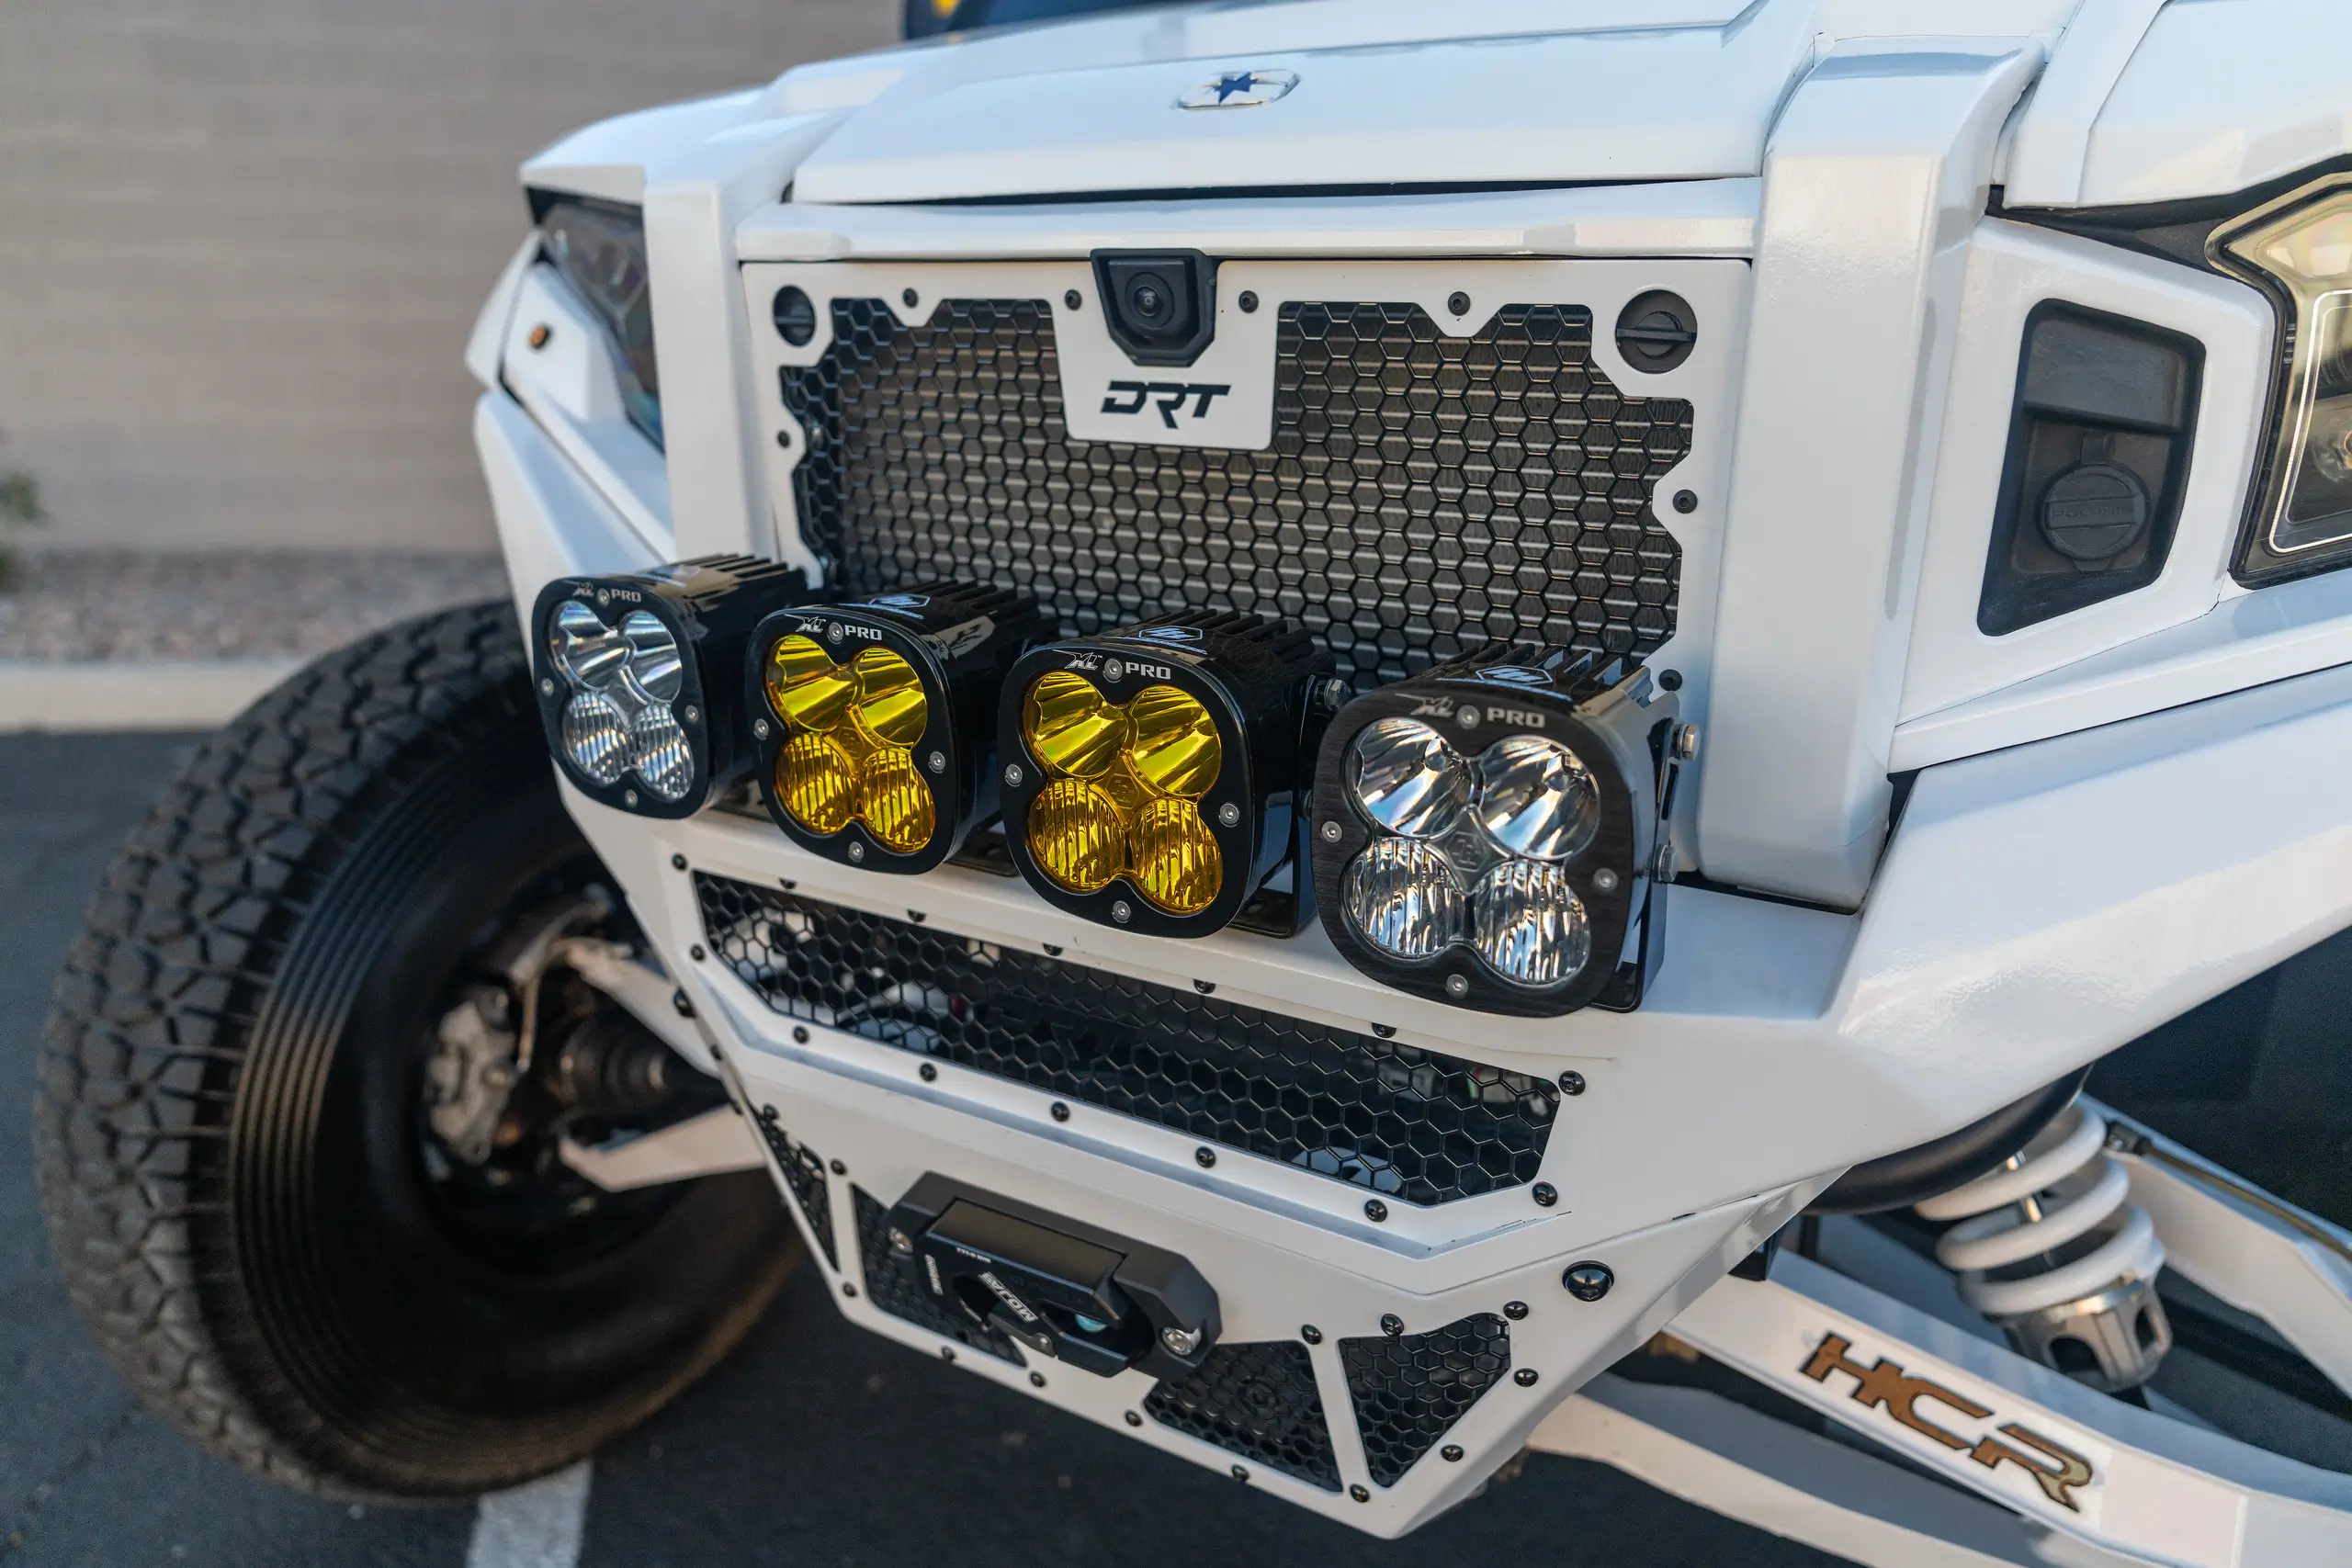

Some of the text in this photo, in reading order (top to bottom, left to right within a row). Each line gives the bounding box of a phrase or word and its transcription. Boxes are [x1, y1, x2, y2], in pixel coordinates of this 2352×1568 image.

[1100, 380, 1232, 429] DRT
[611, 589, 642, 603] PRO
[844, 625, 882, 641] PRO
[1125, 661, 1171, 680] PRO
[1487, 707, 1545, 728] PRO
[1798, 1330, 2092, 1513] HCR
